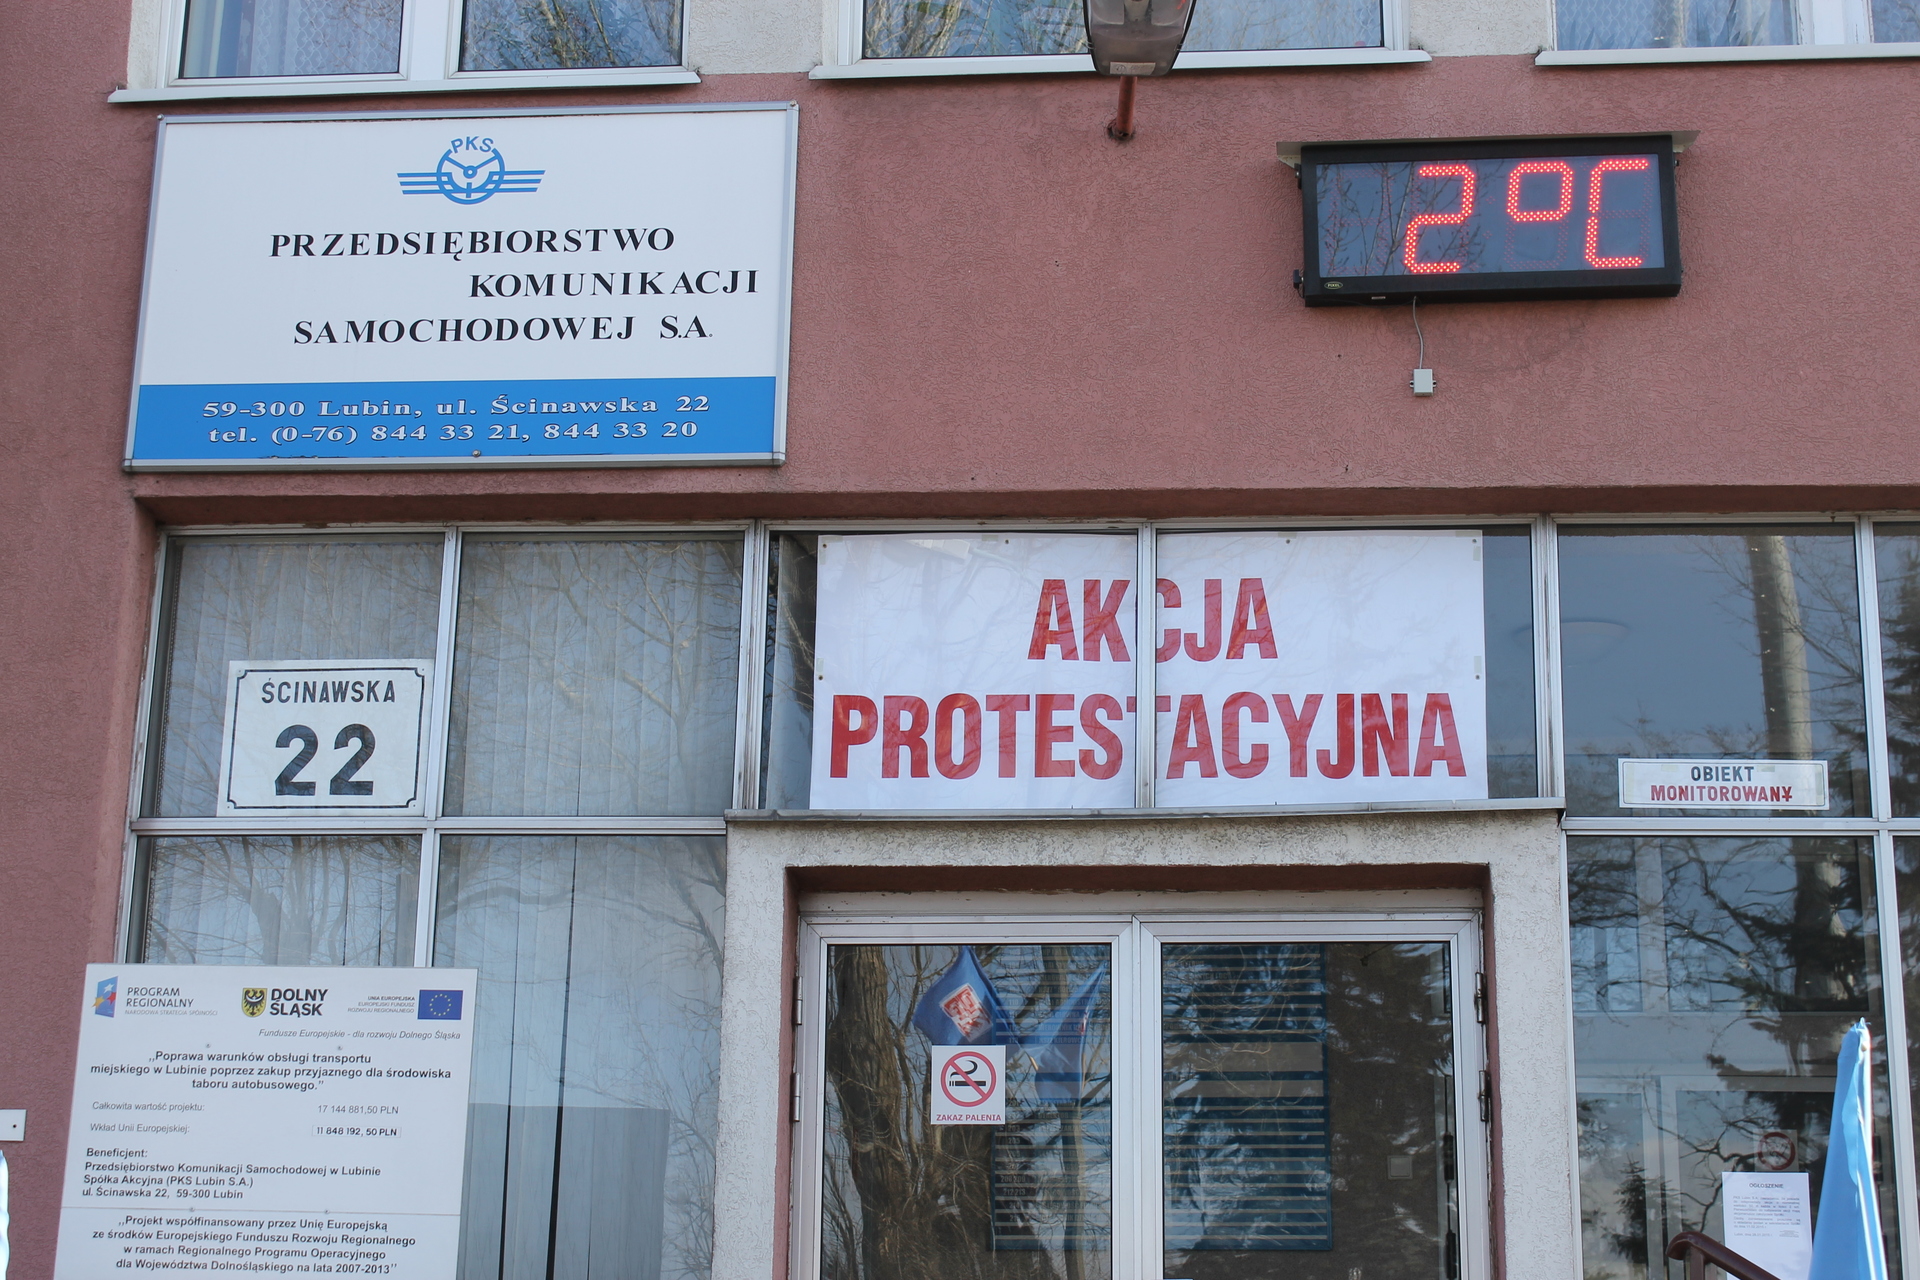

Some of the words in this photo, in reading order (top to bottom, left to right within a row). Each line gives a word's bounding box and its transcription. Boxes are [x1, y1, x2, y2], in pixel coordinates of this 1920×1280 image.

[451, 136, 493, 153] PKS
[271, 228, 674, 261] PRZEDSIĘBIORSTWO
[470, 270, 757, 297] KOMUNIKACJI
[294, 317, 634, 344] SAMOCHODOWEJ
[660, 316, 712, 339] S.A.
[203, 401, 305, 418] 59-300
[317, 400, 422, 419] Lubin,
[436, 399, 477, 415] ul.
[491, 394, 658, 415] Ścinawska
[676, 396, 710, 412] 22
[208, 427, 257, 443] tel.
[271, 426, 358, 446] (0-76)
[371, 425, 427, 441] 844
[439, 424, 474, 440] 33
[488, 424, 530, 443] 21,
[543, 423, 600, 439] 844
[613, 422, 648, 438] 33
[661, 421, 698, 437] 20
[1027, 577, 1278, 662] AKCJA
[262, 678, 395, 703] ŚCINAWSKA
[829, 691, 1467, 780] PROTESACYJNA
[275, 724, 375, 796] 22
[1691, 766, 1754, 781] OBIEKT
[127, 987, 180, 996] PROGRAM
[271, 988, 328, 1002] DOLNY
[126, 998, 193, 1007] REGIONALNY
[270, 1002, 323, 1018] ŚLĄSK
[259, 1029, 297, 1037] Fundusze
[299, 1029, 345, 1039] Europejskie
[353, 1030, 364, 1038] dla
[367, 1032, 397, 1040] rozwoju
[399, 1031, 432, 1040] Dolnego
[435, 1030, 460, 1041] Śląska
[207, 1052, 264, 1061] warunków
[268, 1053, 309, 1065] obsługi
[313, 1054, 371, 1065] transportu
[91, 1064, 150, 1076] miejskiego
[166, 1065, 207, 1074] Lubinie
[210, 1068, 254, 1077] poprzez
[257, 1066, 291, 1078] zakup
[294, 1069, 362, 1079] przyjaznego
[366, 1068, 382, 1077] dla
[386, 1068, 451, 1078] środowiska
[192, 1079, 228, 1088] taboru
[92, 1101, 132, 1110] Całkowita
[169, 1103, 204, 1113] projektu:
[318, 1105, 328, 1113] 17
[331, 1105, 346, 1113] 144
[349, 1105, 378, 1114] 881,50
[380, 1106, 398, 1114] PLN
[90, 1123, 116, 1131] Wkład
[118, 1124, 134, 1132] Unii
[137, 1124, 189, 1134] Europejskiej:
[326, 1127, 343, 1135] 848
[347, 1127, 363, 1136] 192,
[366, 1128, 377, 1136] 50
[379, 1128, 397, 1136] PLN
[87, 1148, 147, 1159] Beneficjent:
[85, 1162, 174, 1173] Przedsiębiorstwo
[178, 1163, 242, 1175] Komunikacji
[246, 1164, 326, 1177] Samochodowej
[342, 1166, 381, 1176] Lubinie
[84, 1174, 118, 1185] Spółka
[121, 1175, 163, 1186] Akcyjna
[167, 1176, 192, 1186] (PKS
[196, 1177, 225, 1185] Lubin
[229, 1177, 253, 1188] S.A.)
[82, 1187, 93, 1196] ul.
[96, 1185, 151, 1197] Ścinawska
[155, 1188, 169, 1198] 22,
[177, 1189, 210, 1198] 59-300
[214, 1190, 243, 1198] Lubin
[166, 1217, 264, 1229] współfinansowany
[268, 1221, 296, 1229] przez
[300, 1219, 323, 1230] Unię
[327, 1220, 387, 1232] Europejską
[108, 1230, 153, 1239] środków
[156, 1230, 232, 1243] Europejskiego
[236, 1232, 288, 1242] Funduszu
[292, 1233, 337, 1245] Rozwoju
[341, 1235, 415, 1247] Regionalnego
[135, 1245, 174, 1254] ramach
[178, 1245, 251, 1258] Regionalnego
[255, 1247, 307, 1259] Programu
[311, 1248, 386, 1261] Operacyjnego
[116, 1259, 131, 1268] dla
[136, 1259, 207, 1271] Województwa
[211, 1261, 293, 1274] Dolnośląskiego
[313, 1263, 332, 1272] lata
